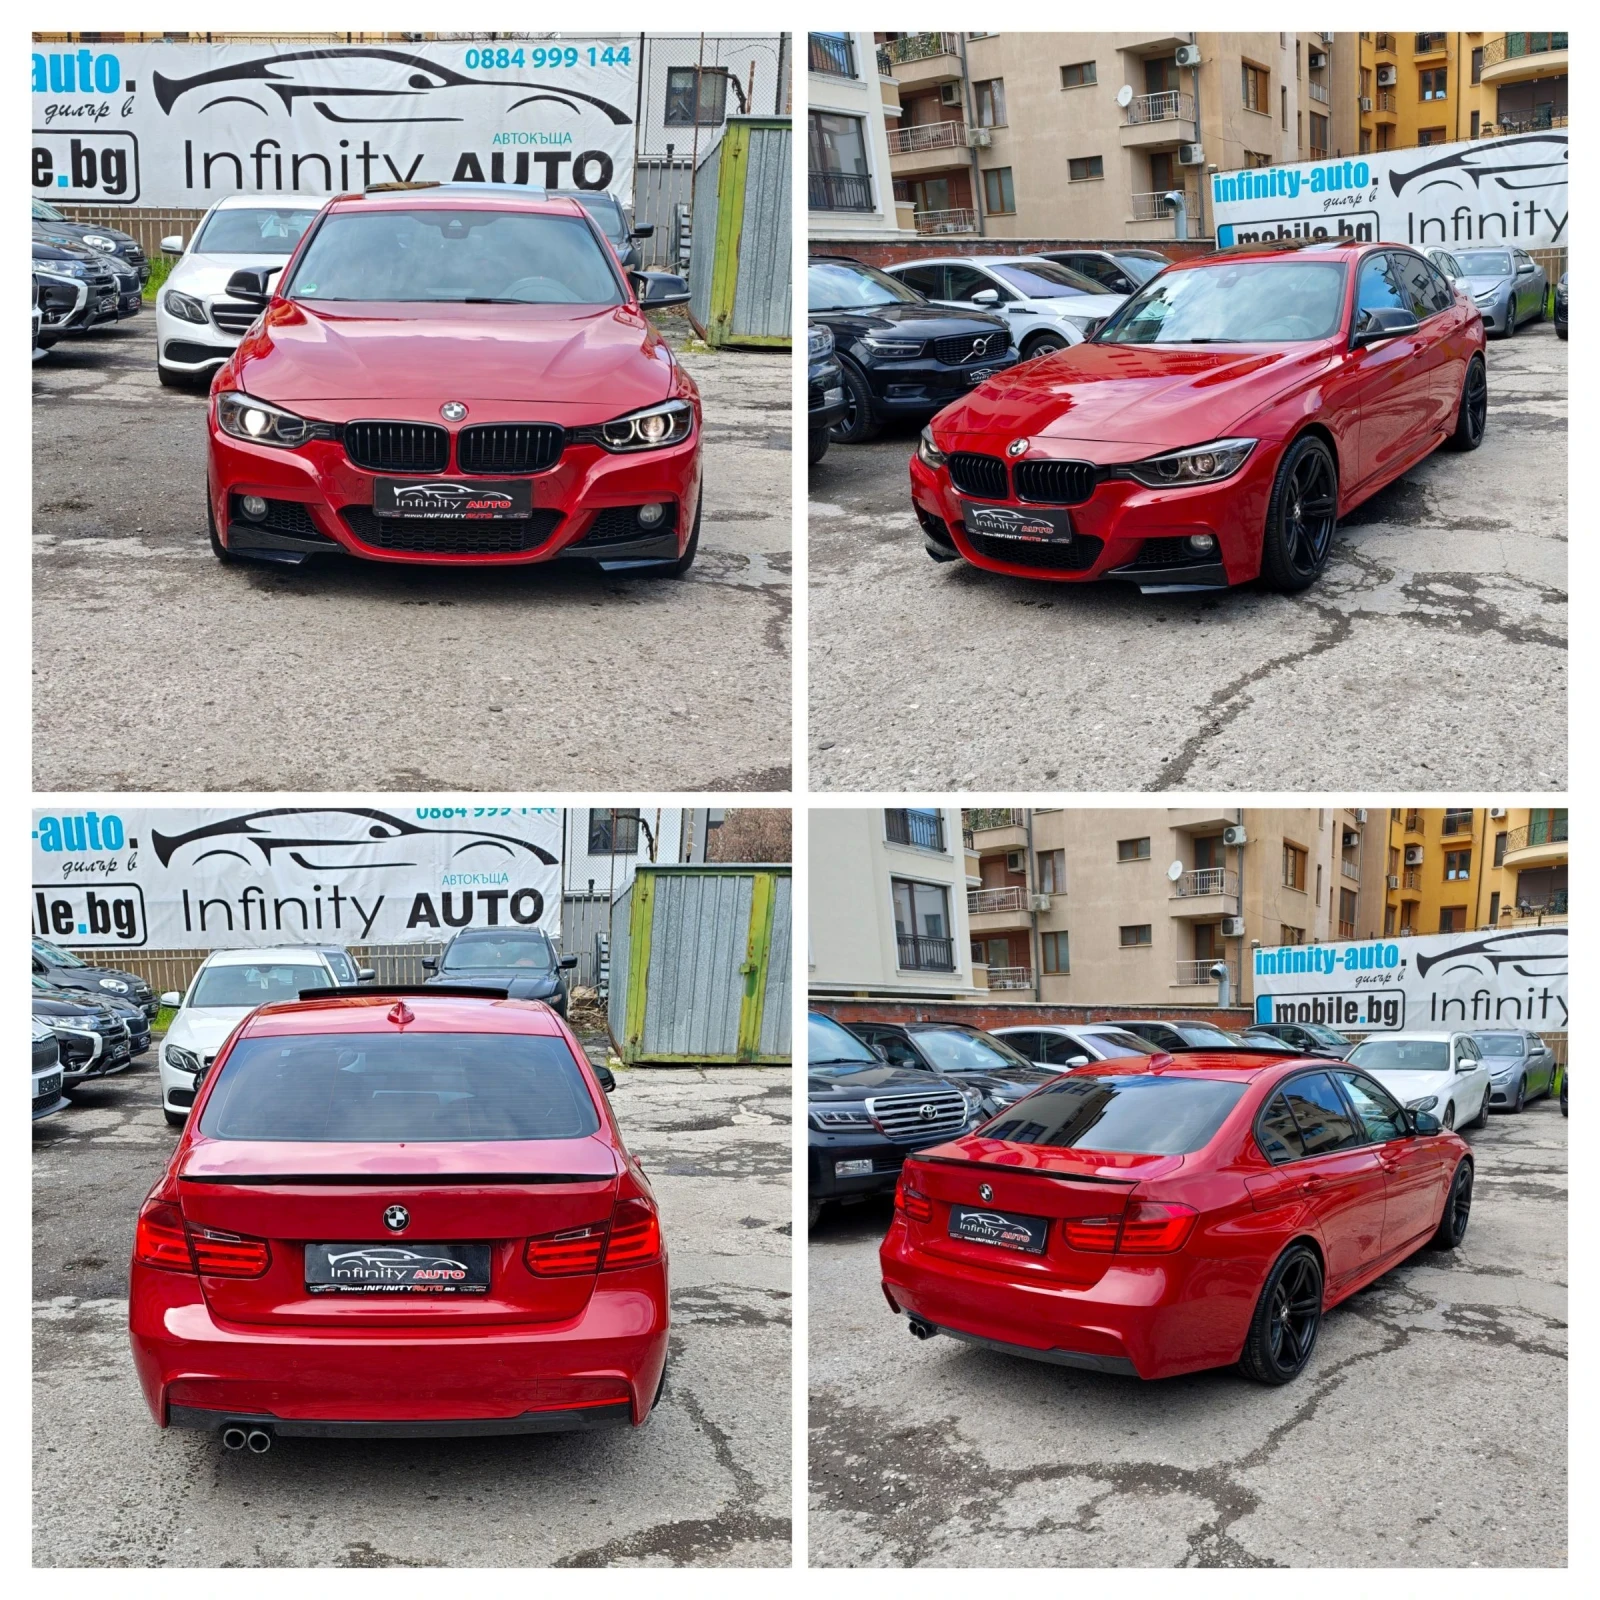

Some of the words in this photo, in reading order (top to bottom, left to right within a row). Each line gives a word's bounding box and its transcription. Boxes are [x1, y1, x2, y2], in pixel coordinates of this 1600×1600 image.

[465, 48, 525, 69] 0884
[531, 47, 579, 68] 999
[586, 46, 631, 66] 144
[492, 132, 573, 146] АВТОКЪЩА
[184, 138, 424, 191] Infinity
[451, 150, 614, 190] AUTO
[1408, 200, 1568, 243] Infinity
[396, 497, 461, 510] Infinity
[466, 500, 512, 509] AUTO
[976, 519, 1017, 531] Infinity
[1021, 525, 1054, 534] AUTO
[442, 872, 509, 885] АВТОКЪЩА
[182, 885, 385, 939] Infinity
[406, 888, 544, 928] AUTO
[1275, 995, 1398, 1027] mobile.bg
[960, 1222, 998, 1236] Infinity
[1001, 1231, 1030, 1242] AUTO
[331, 1268, 407, 1280] Infinity
[413, 1269, 466, 1279] AUTO
